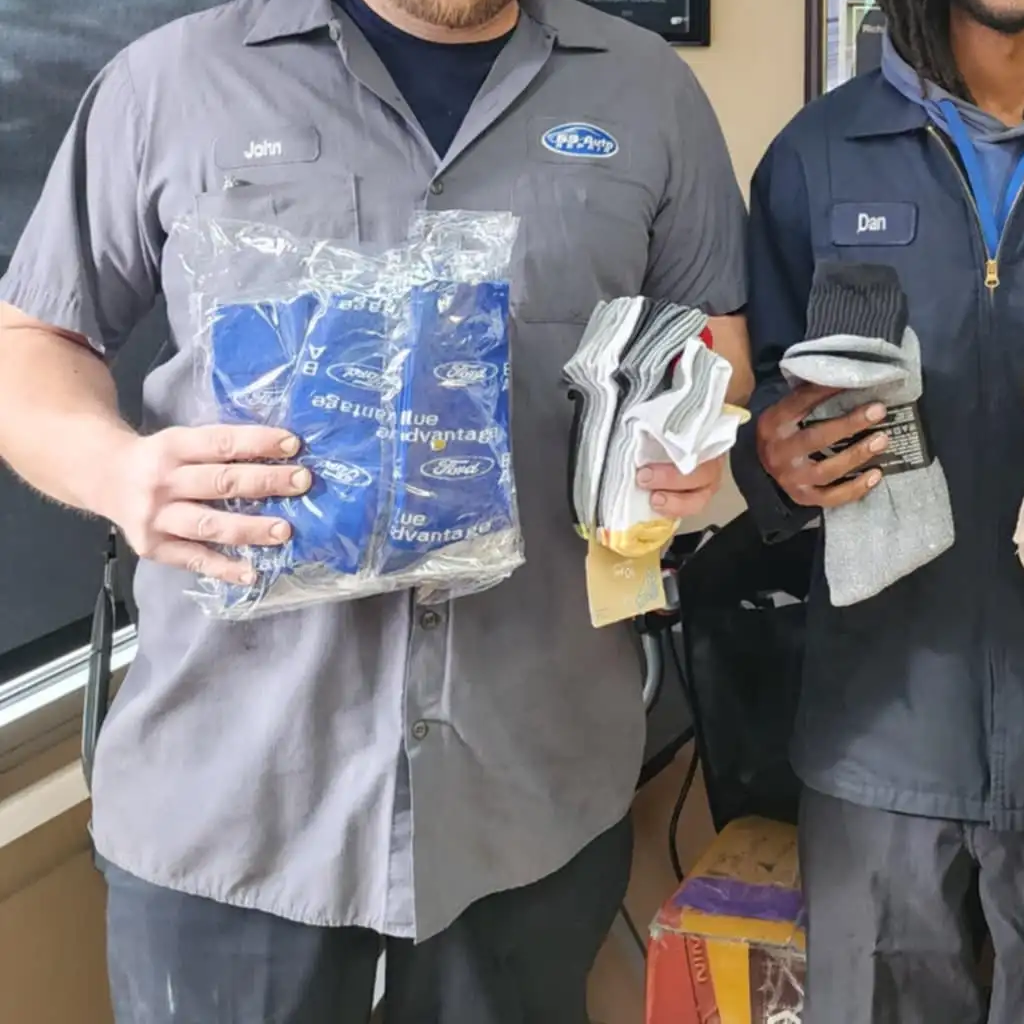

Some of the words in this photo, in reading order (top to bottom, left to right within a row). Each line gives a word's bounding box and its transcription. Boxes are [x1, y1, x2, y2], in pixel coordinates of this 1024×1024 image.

[243, 140, 282, 159] John
[856, 212, 887, 234] Dan
[433, 459, 478, 475] Ford
